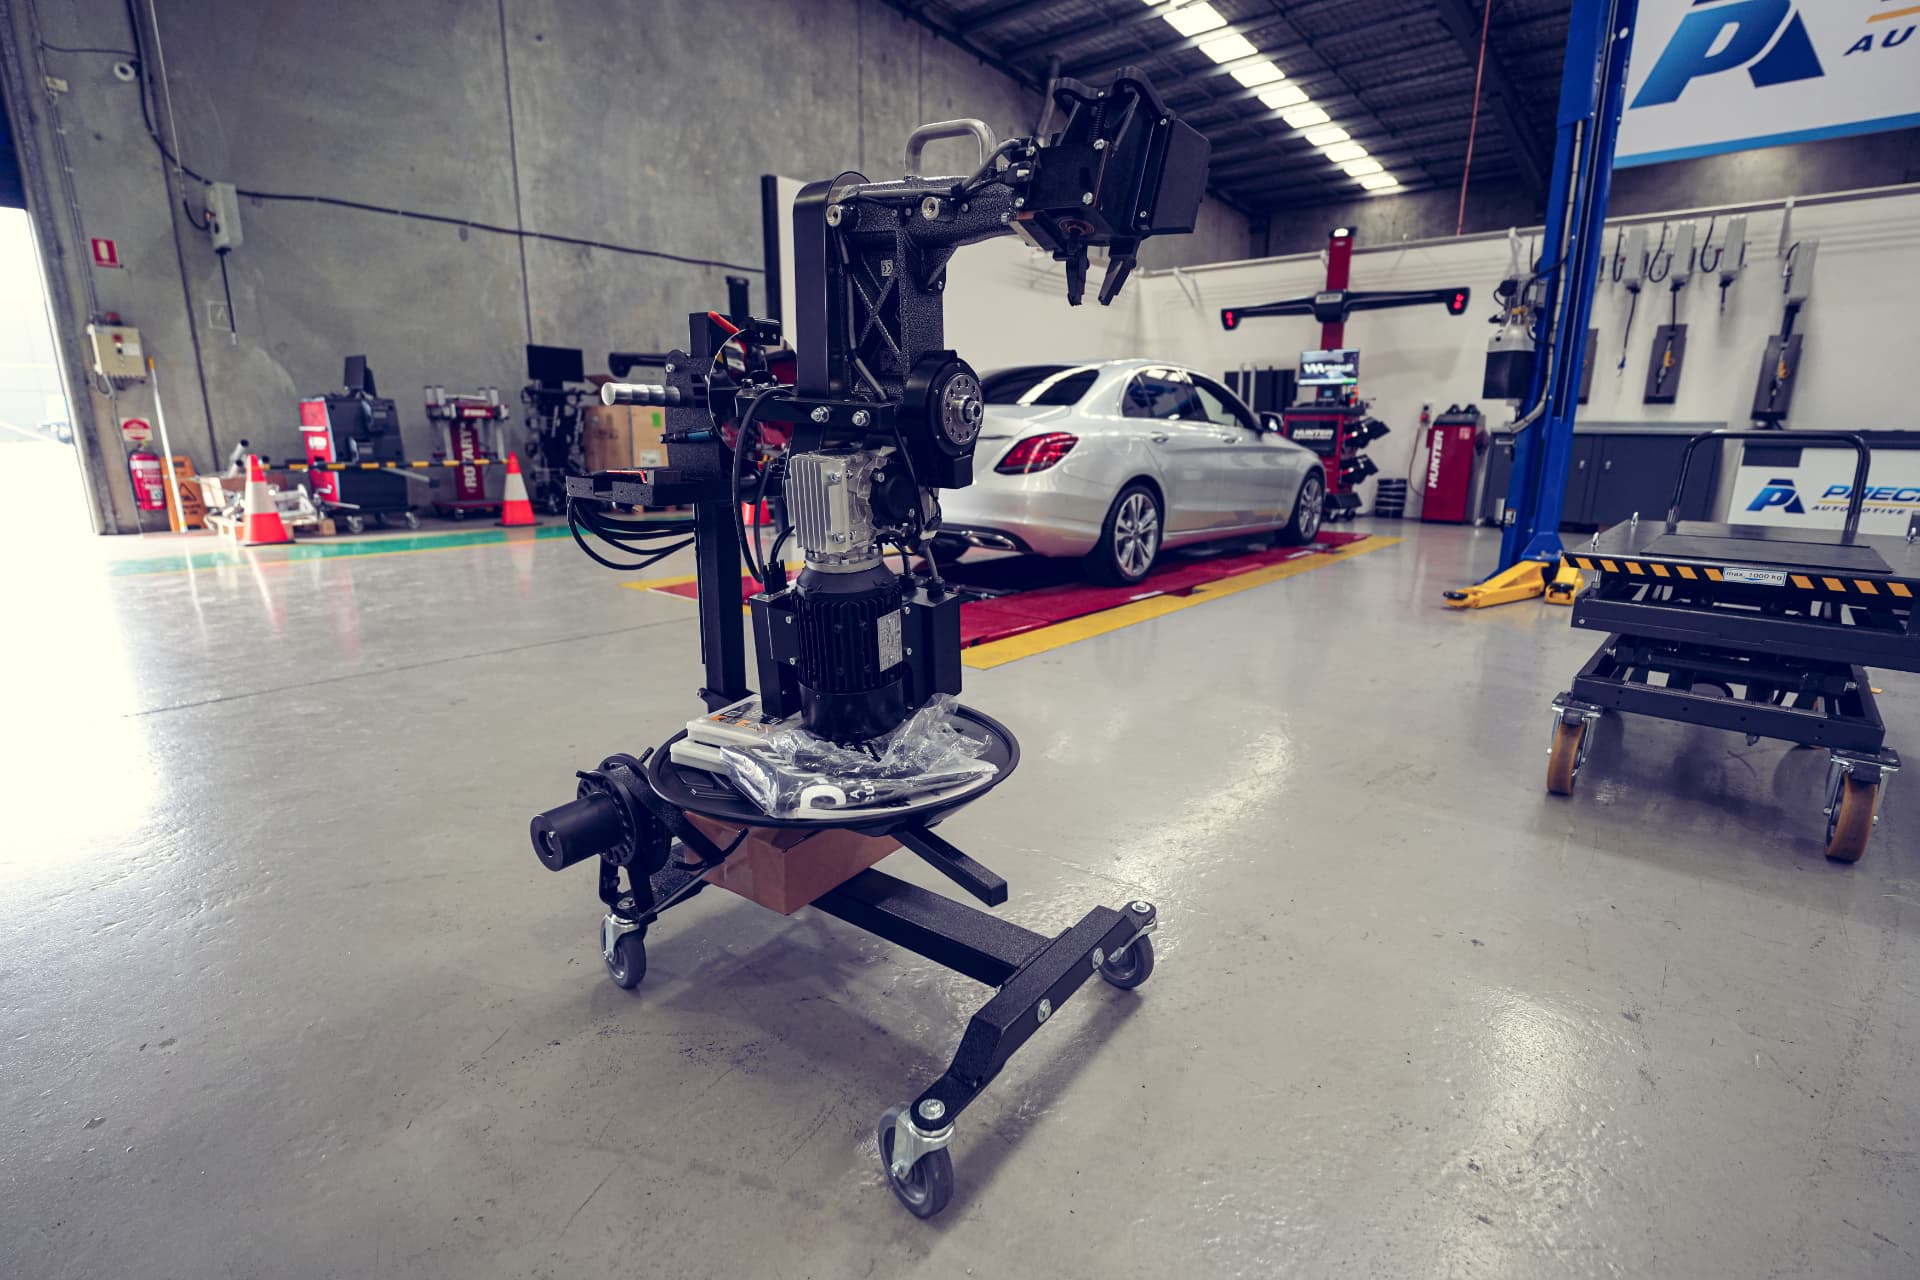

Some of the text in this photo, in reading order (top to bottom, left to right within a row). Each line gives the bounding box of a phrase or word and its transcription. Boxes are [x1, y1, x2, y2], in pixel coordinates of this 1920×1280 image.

[461, 430, 477, 488] ROARY
[1428, 430, 1444, 488] HUNTER
[1811, 505, 1906, 515] AUTOOTIVE
